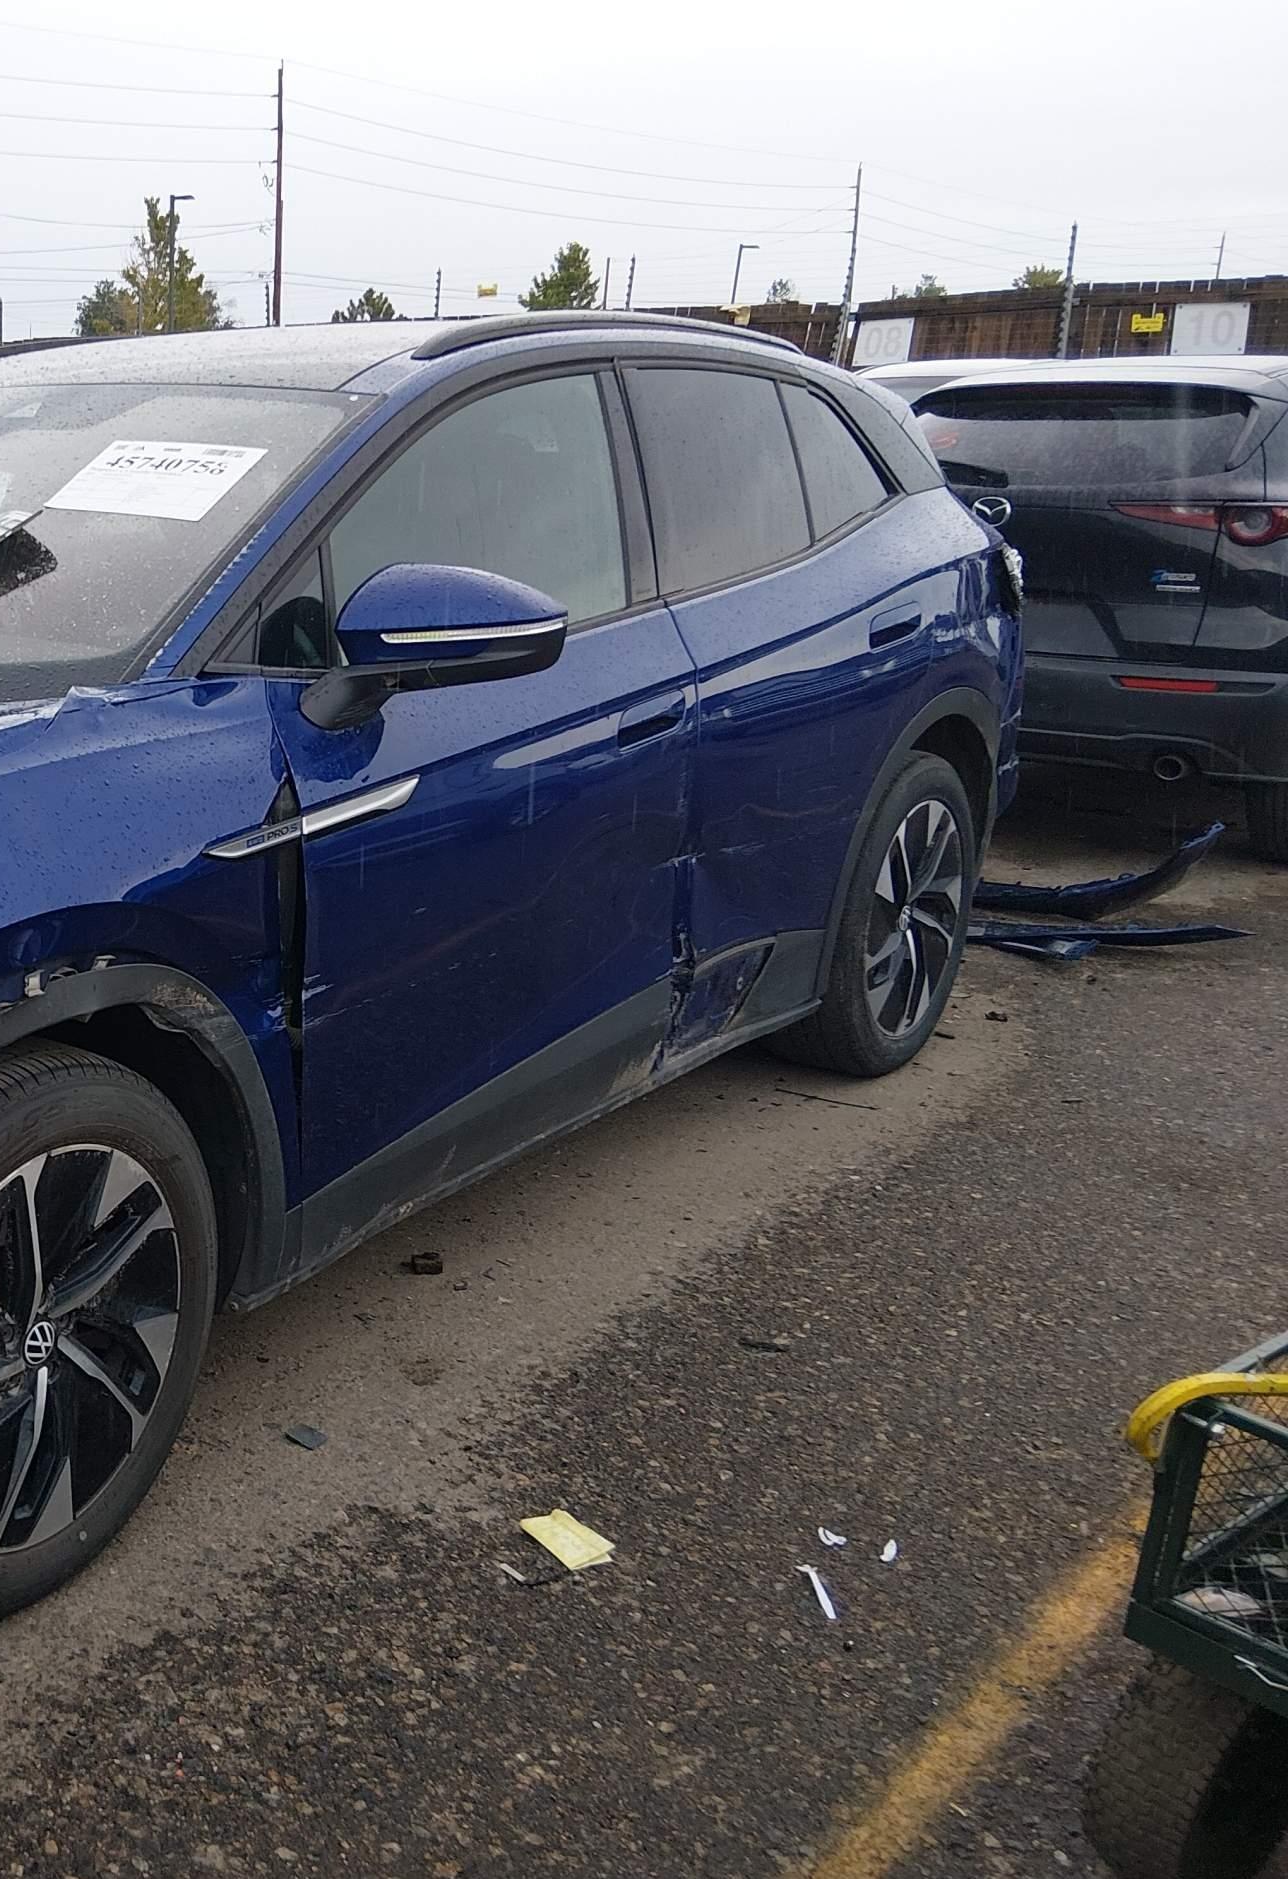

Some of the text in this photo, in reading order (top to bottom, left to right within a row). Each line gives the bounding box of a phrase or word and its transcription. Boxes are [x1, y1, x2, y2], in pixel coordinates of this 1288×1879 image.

[864, 326, 905, 358] 08
[1189, 309, 1236, 347] 10
[267, 826, 289, 841] PRO
